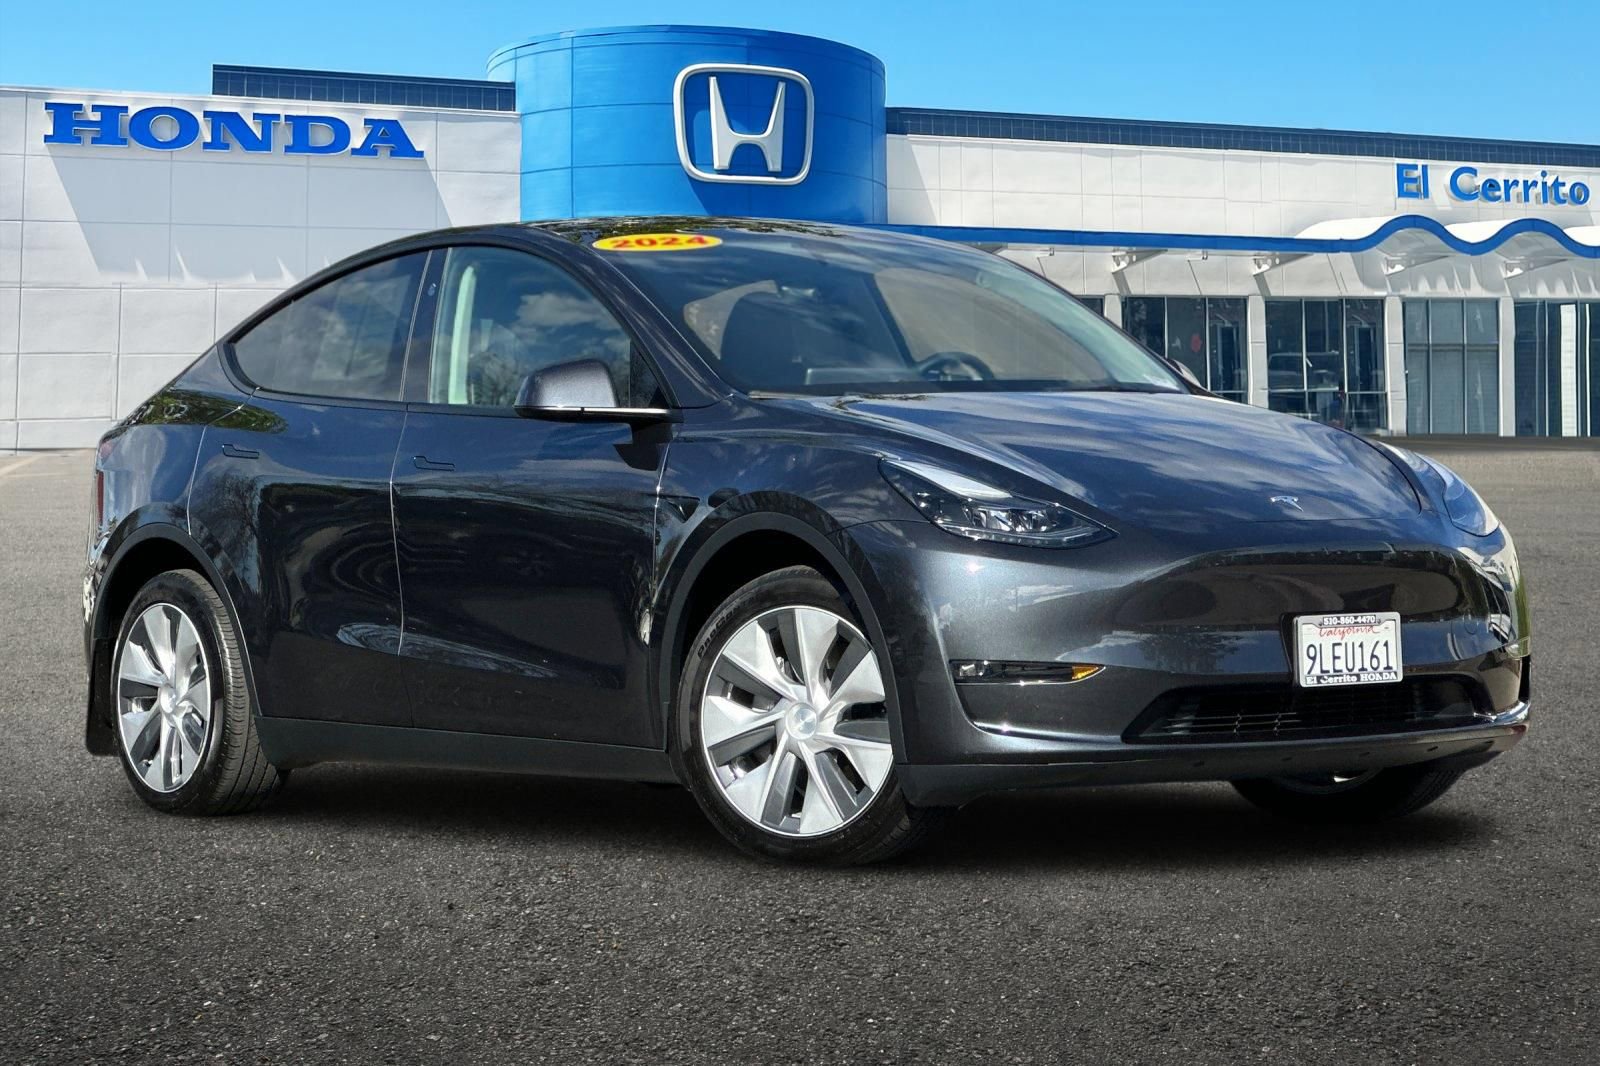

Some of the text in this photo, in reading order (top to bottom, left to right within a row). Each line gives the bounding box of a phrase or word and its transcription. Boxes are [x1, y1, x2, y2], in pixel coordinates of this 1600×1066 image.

[44, 102, 425, 158] HONDA
[1396, 163, 1591, 206] El Cerrito
[610, 235, 708, 248] 2024
[1319, 626, 1380, 640] California
[1306, 640, 1393, 674] 9LEU161
[1306, 672, 1396, 685] El Cerrito HONDA
